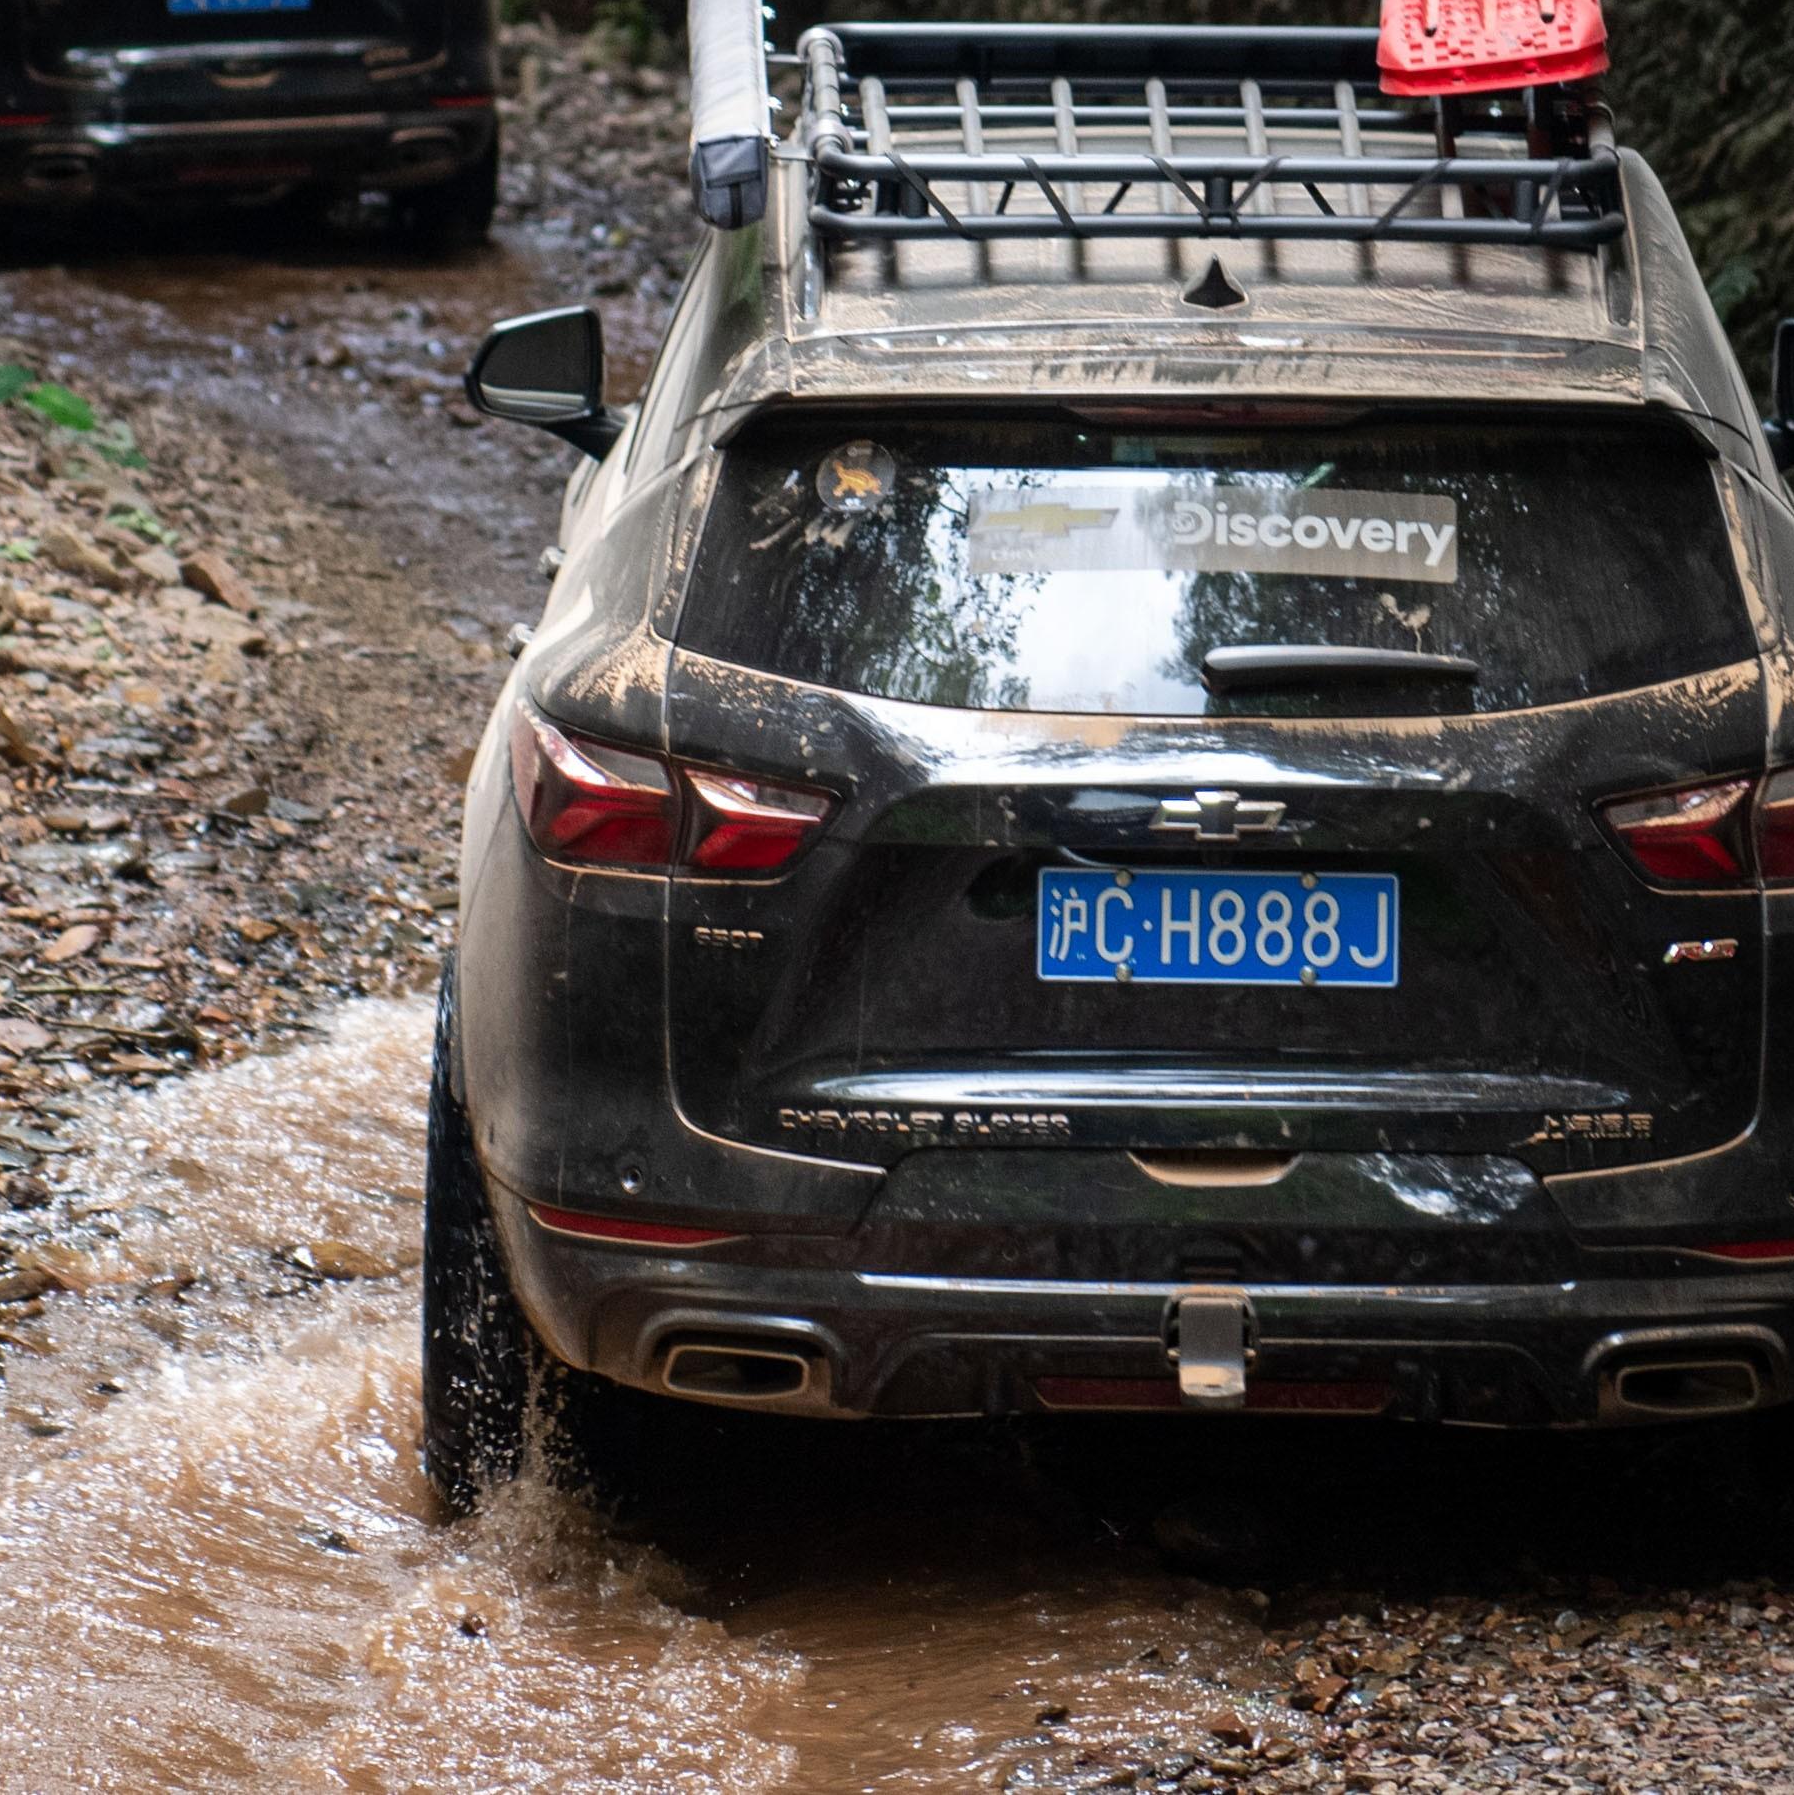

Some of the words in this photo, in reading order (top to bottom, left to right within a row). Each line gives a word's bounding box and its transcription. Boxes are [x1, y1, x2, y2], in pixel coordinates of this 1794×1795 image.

[1172, 501, 1456, 567] Discovery
[779, 1108, 944, 1134] CHEVROLET
[954, 1110, 1071, 1136] BLAZER
